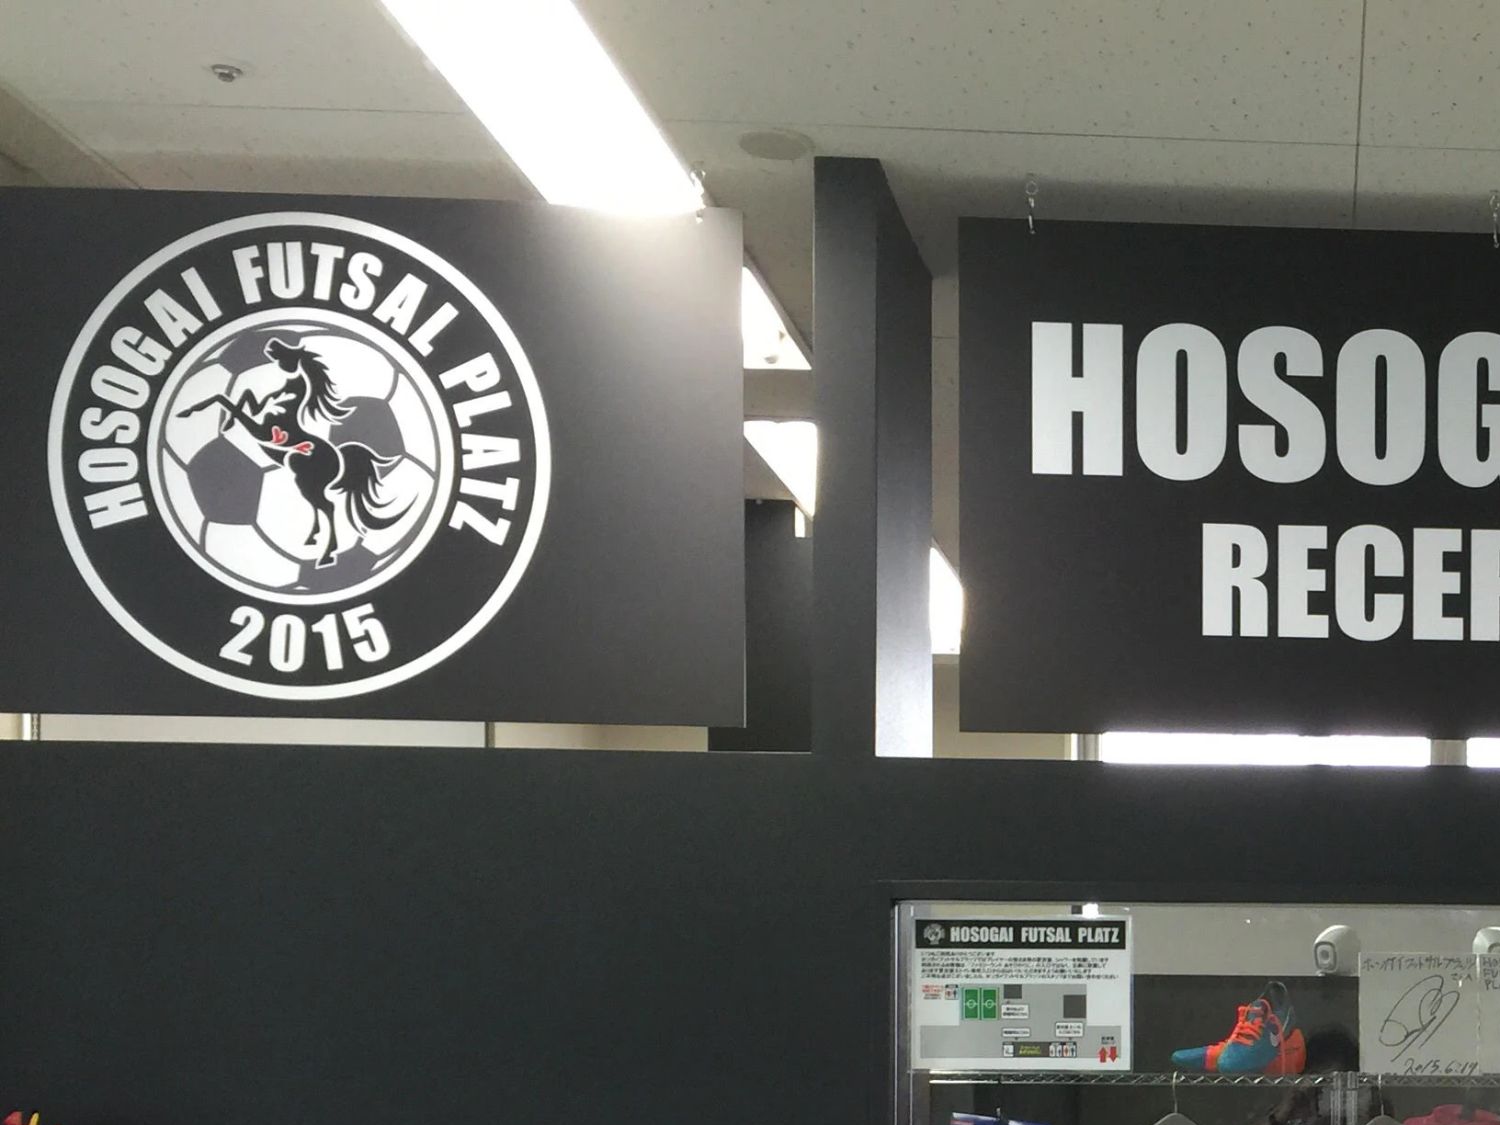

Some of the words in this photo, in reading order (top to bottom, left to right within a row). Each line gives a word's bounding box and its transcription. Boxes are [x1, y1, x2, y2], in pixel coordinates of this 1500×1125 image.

[78, 270, 224, 530] HOSOGAI
[232, 241, 459, 358] FUTSAL
[438, 351, 521, 547] PLATZ
[218, 603, 392, 672] 2015
[950, 926, 1014, 944] HOSOGAI
[1021, 926, 1072, 944] FUTSAL
[1078, 926, 1120, 944] PLATZ
